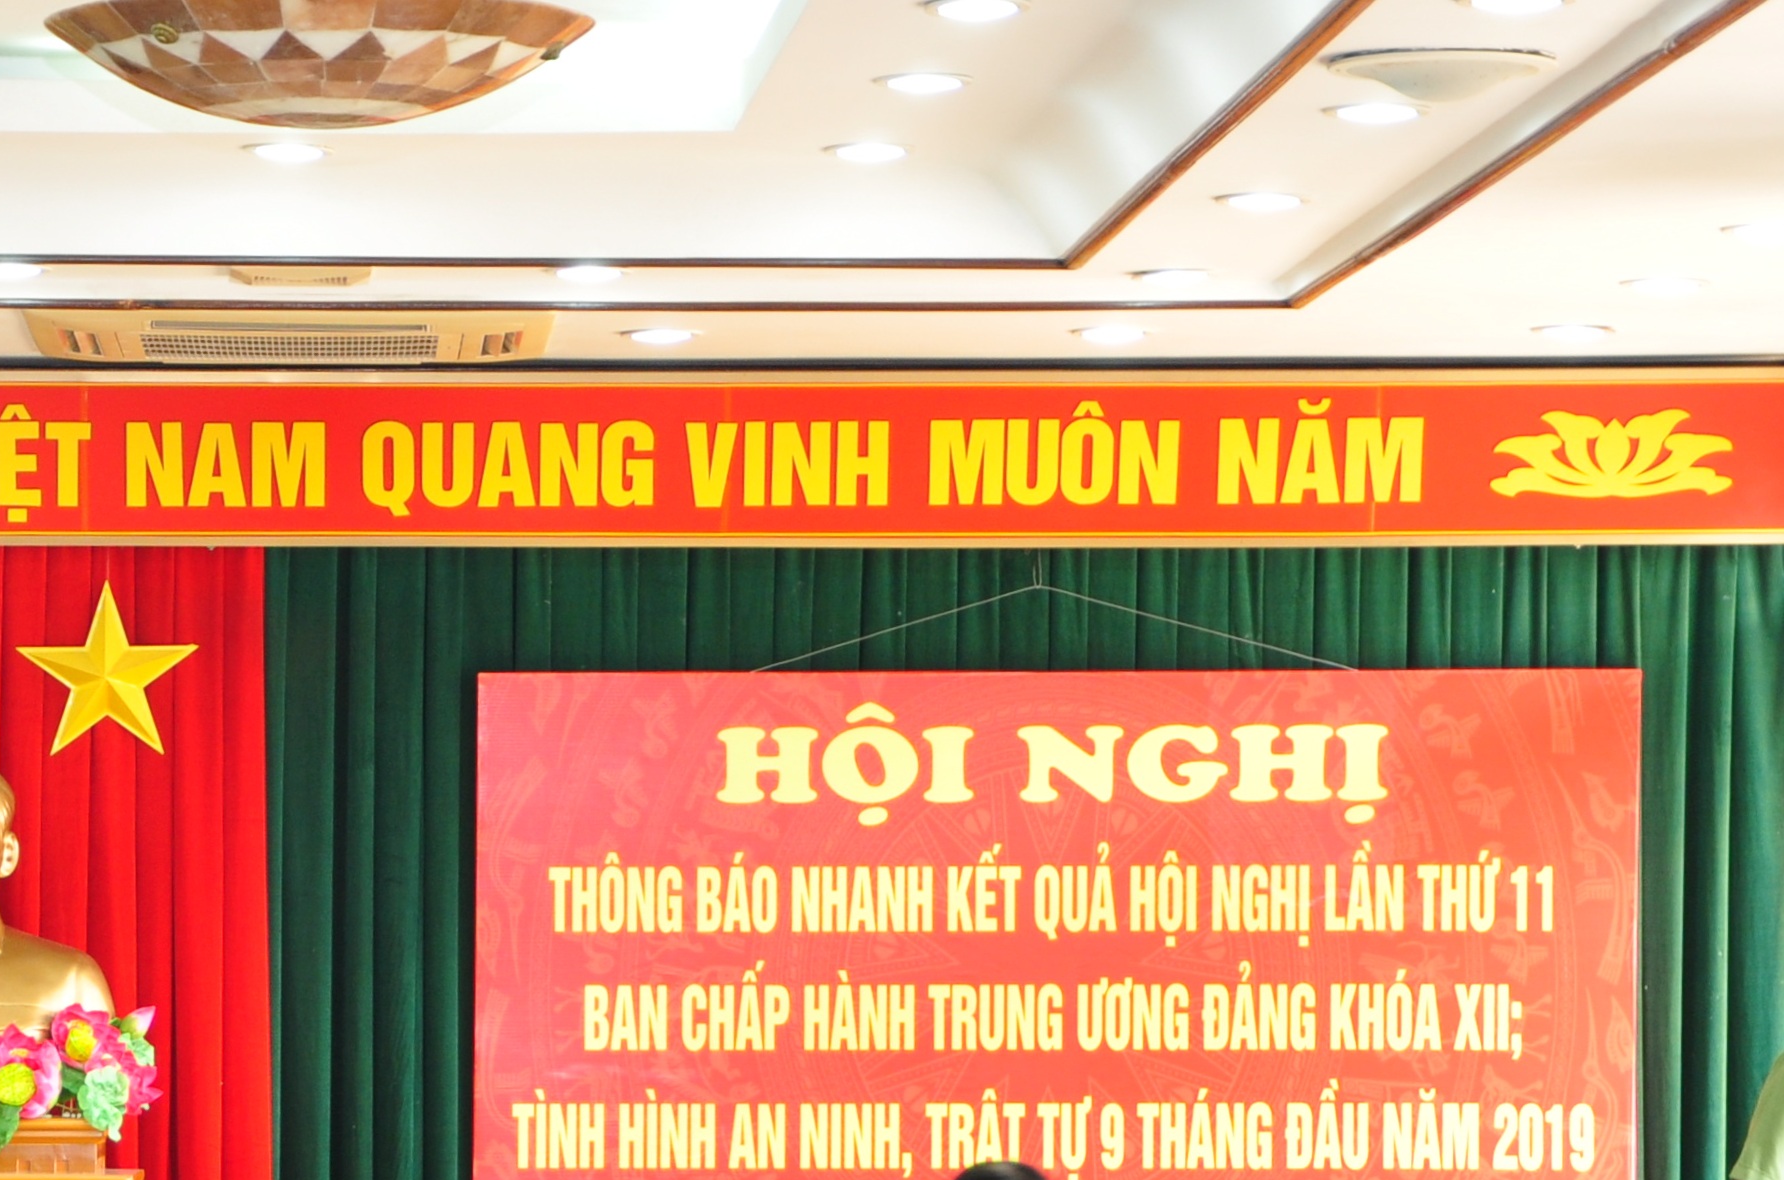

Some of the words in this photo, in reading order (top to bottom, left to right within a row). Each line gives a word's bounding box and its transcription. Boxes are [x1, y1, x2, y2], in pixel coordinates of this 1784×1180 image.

[126, 421, 326, 508] NAM
[362, 420, 655, 517] QUANG
[685, 420, 890, 508] VINH
[928, 401, 1181, 507] MUÔN
[1216, 398, 1425, 506] NĂM
[715, 702, 975, 828] HỘI
[1016, 722, 1390, 826] NGHỊ
[547, 851, 684, 934] THÔNG
[695, 851, 779, 934] BÁO
[790, 864, 934, 934] NHANH
[946, 843, 1023, 933] KẾT
[1033, 841, 1118, 941] QUẢ
[1129, 850, 1198, 948] HỘI
[1211, 864, 1313, 948] NGHỊ
[1324, 839, 1405, 933] LẦN
[1416, 849, 1507, 934] THỨ
[1510, 866, 1555, 933] 11
[583, 984, 669, 1053] BAN
[681, 960, 791, 1053] CHẤP
[803, 969, 916, 1052] HÀNH
[927, 983, 1064, 1053] TRUNG
[1076, 976, 1190, 1052] ƯƠNG
[1201, 960, 1317, 1053] ĐẢNG
[1329, 968, 1443, 1053] KHÓA
[1454, 983, 1525, 1062] XII;
[511, 1087, 606, 1171] TÌNH
[617, 1087, 717, 1170] HÌNH
[728, 1102, 787, 1171] AN
[799, 1102, 913, 1179] NINH,
[1099, 1102, 1126, 1172] 9
[1136, 1087, 1274, 1172] THÁNG
[1284, 1077, 1371, 1172] ĐẦU
[1382, 1087, 1483, 1171] NĂM
[1492, 1102, 1596, 1174] 2019
